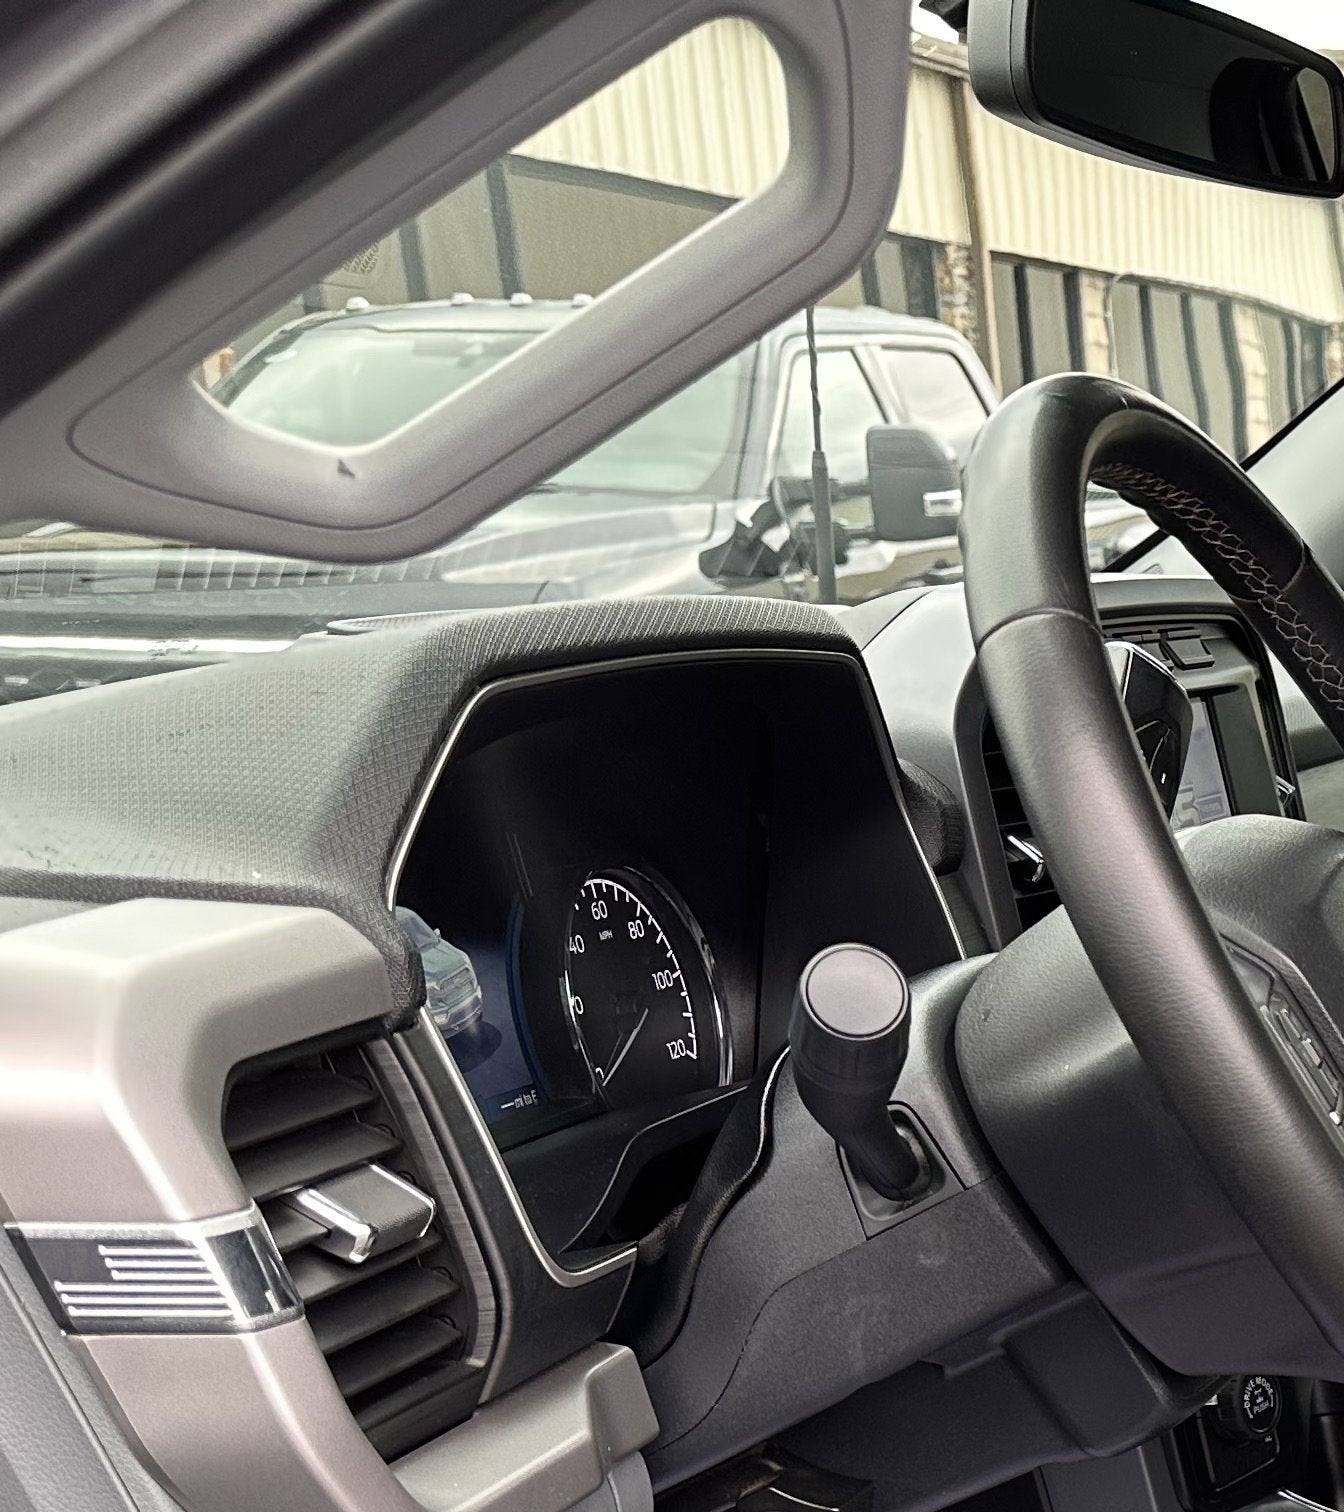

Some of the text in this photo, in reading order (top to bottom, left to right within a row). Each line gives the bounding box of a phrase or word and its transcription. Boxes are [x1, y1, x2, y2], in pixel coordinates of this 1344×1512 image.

[591, 900, 608, 920] 60
[599, 930, 614, 941] MPH
[628, 920, 645, 940] 80
[569, 934, 585, 954] 40
[652, 970, 674, 990] 100
[666, 1039, 686, 1060] 120
[1243, 1376, 1274, 1409] DRIVE MODE
[1253, 1400, 1270, 1415] PUSH
